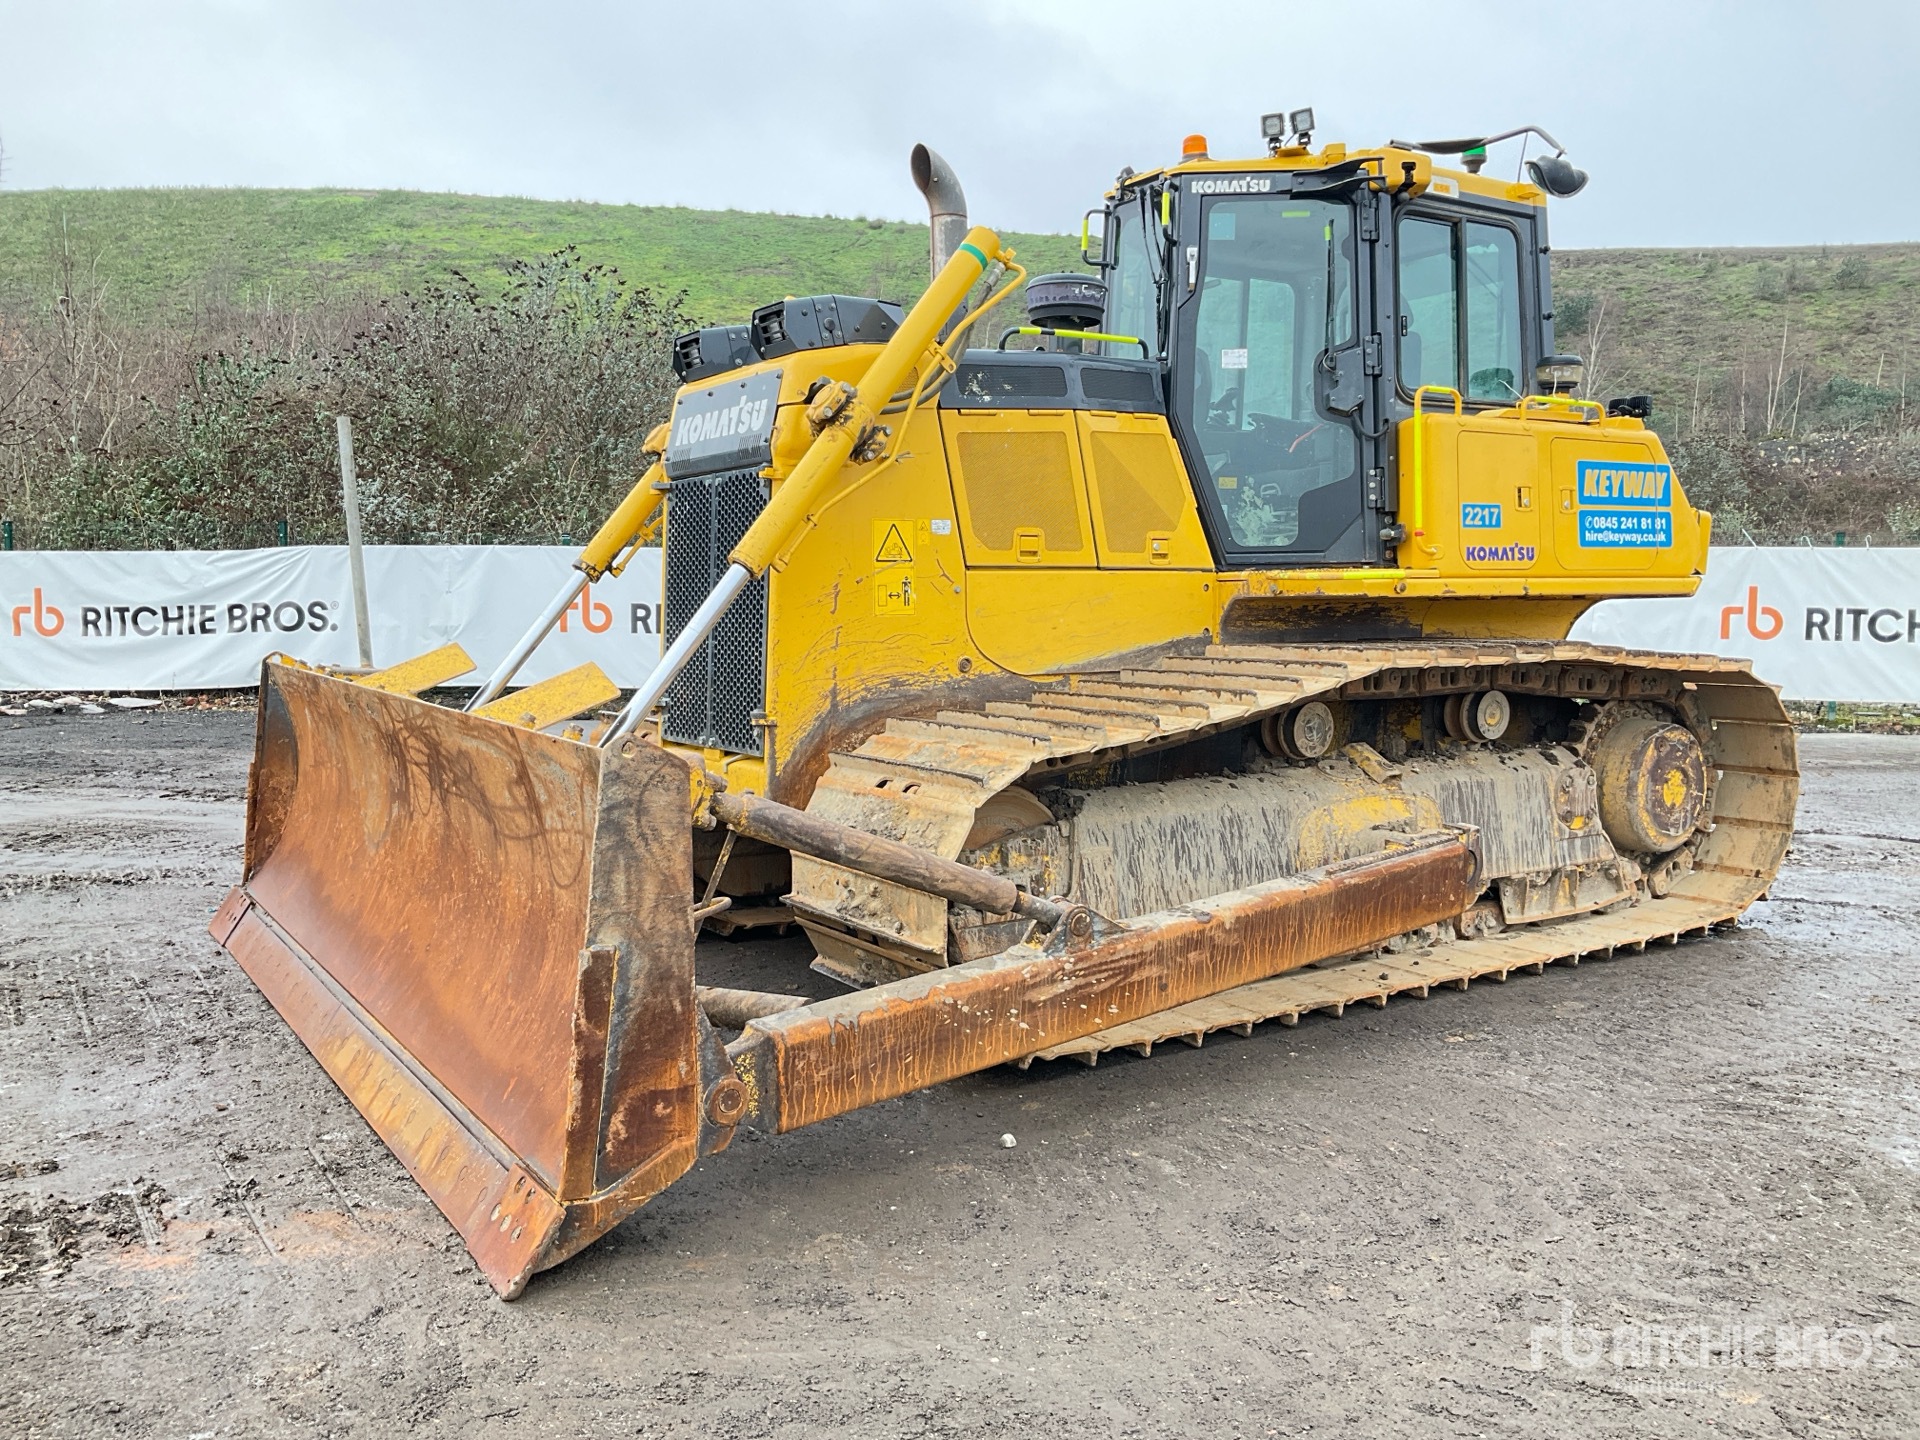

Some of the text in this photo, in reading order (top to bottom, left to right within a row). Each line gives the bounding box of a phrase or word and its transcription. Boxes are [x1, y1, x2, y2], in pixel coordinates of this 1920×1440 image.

[1191, 177, 1271, 194] KOMATSU
[675, 394, 769, 448] KOMATSU
[1583, 468, 1668, 499] KEYWAY
[1464, 507, 1499, 526] 2217
[1593, 516, 1667, 530] 0845 241 81 81
[1585, 530, 1667, 545] hire@keyway.co.uk
[1465, 542, 1535, 562] KOMATSU
[11, 587, 65, 637] rb
[81, 604, 217, 637] RITCHIE
[1720, 585, 1784, 641] rb
